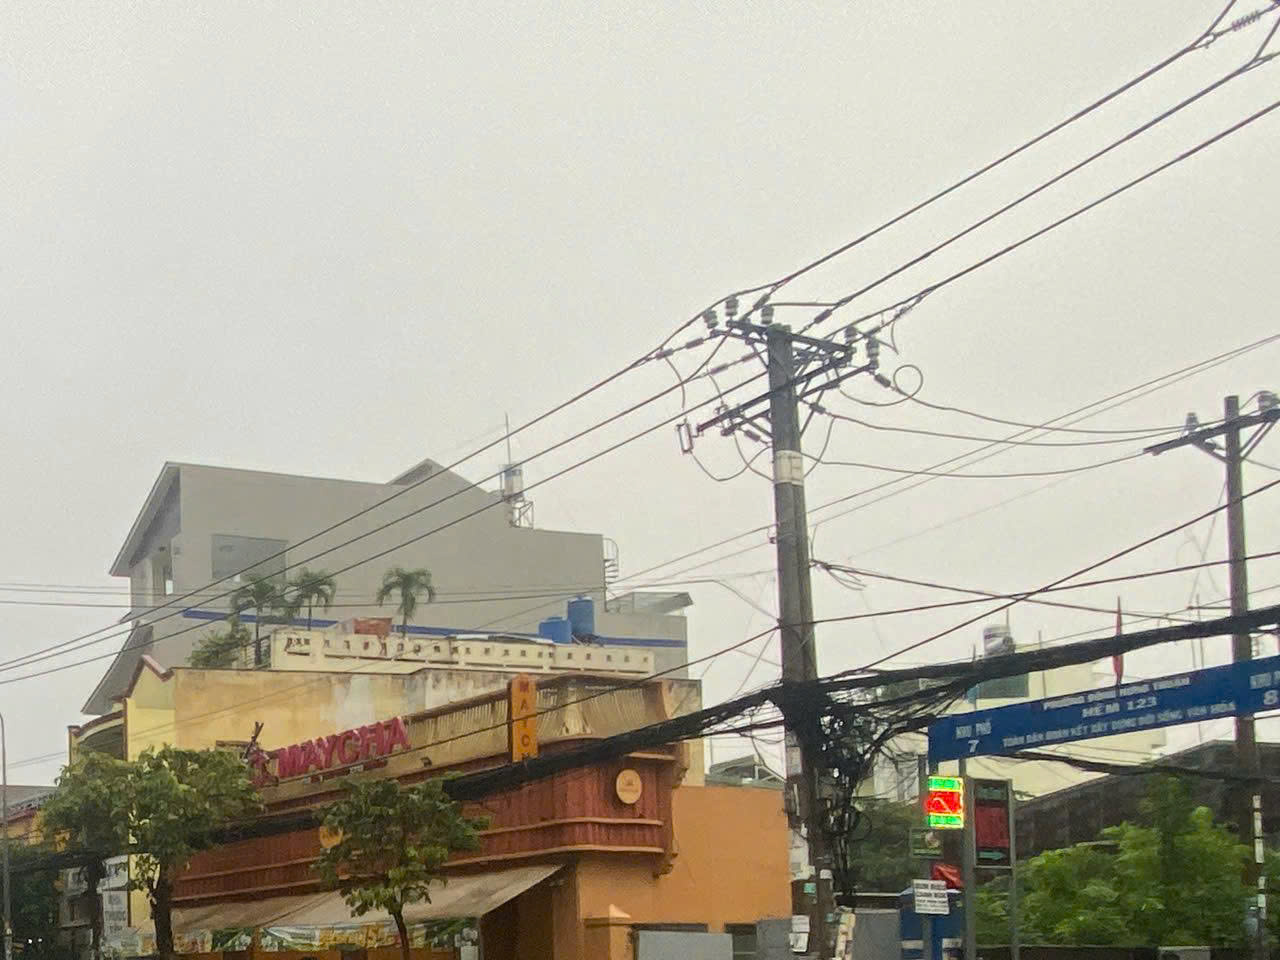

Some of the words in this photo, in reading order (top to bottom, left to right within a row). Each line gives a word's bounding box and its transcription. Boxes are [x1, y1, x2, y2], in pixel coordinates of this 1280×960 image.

[1126, 695, 1158, 711] 123
[1263, 689, 1279, 706] 8
[277, 715, 411, 779] MAYCHA
[967, 739, 980, 753] 7
